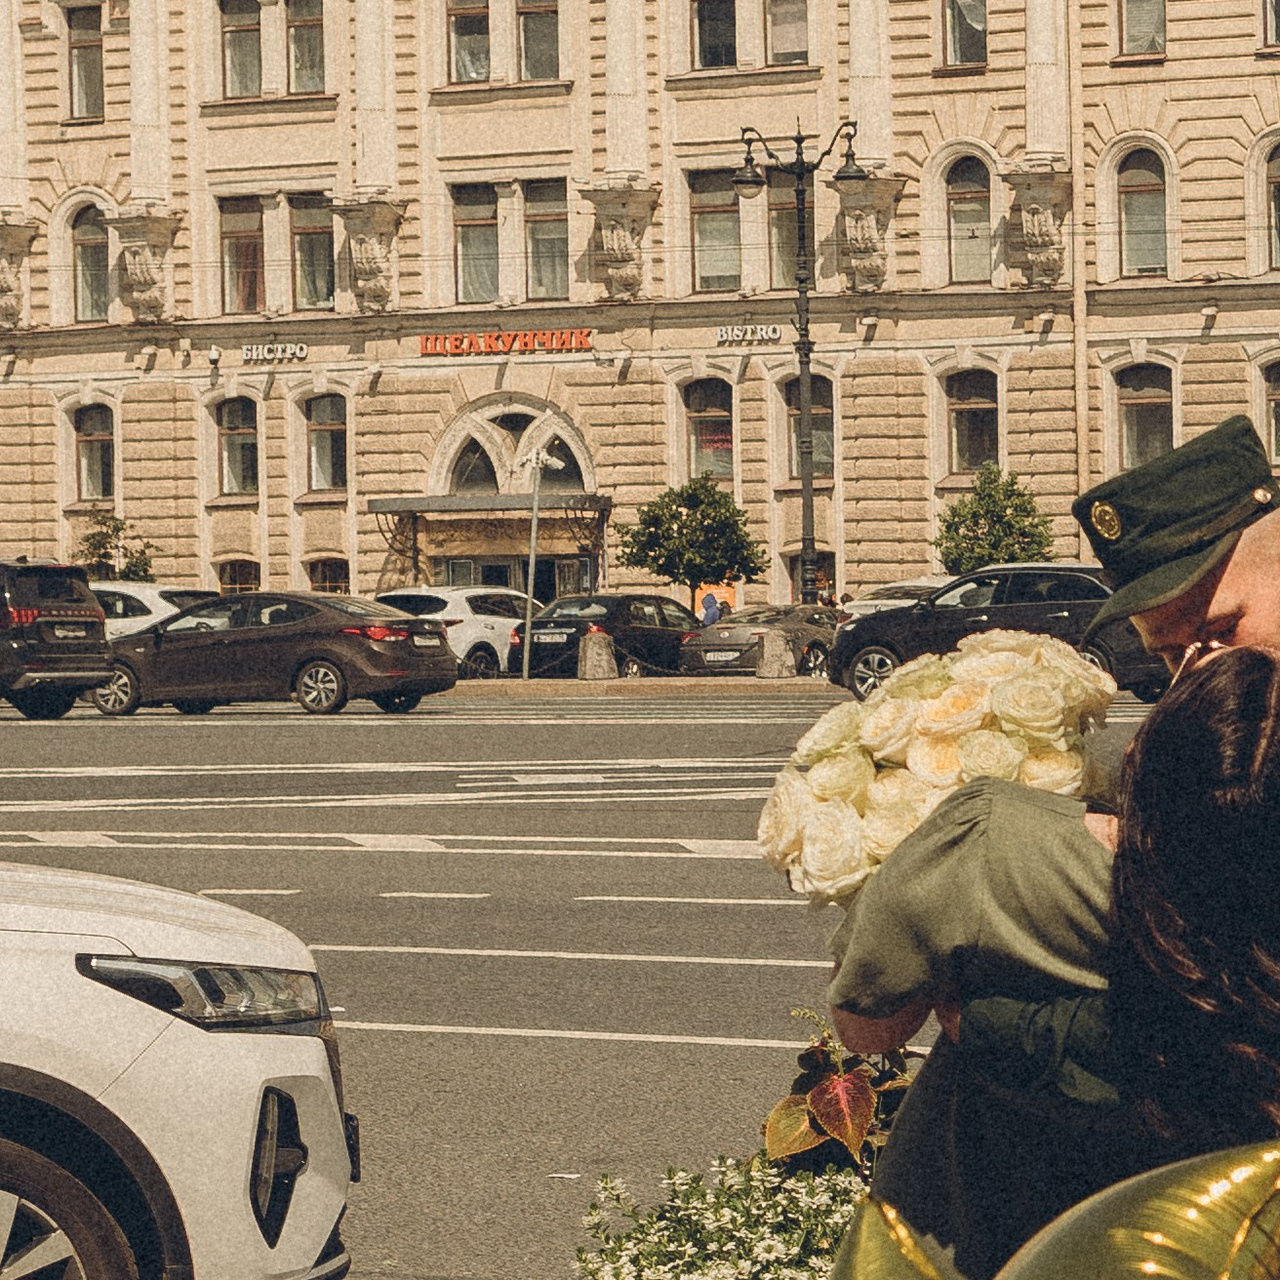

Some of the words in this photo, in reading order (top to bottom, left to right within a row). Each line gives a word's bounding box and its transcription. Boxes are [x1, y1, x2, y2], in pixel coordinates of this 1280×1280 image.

[717, 324, 781, 342] BISTRO
[241, 342, 308, 360] БИСТРО
[420, 328, 592, 357] ЩЕЛКУНЧИК
